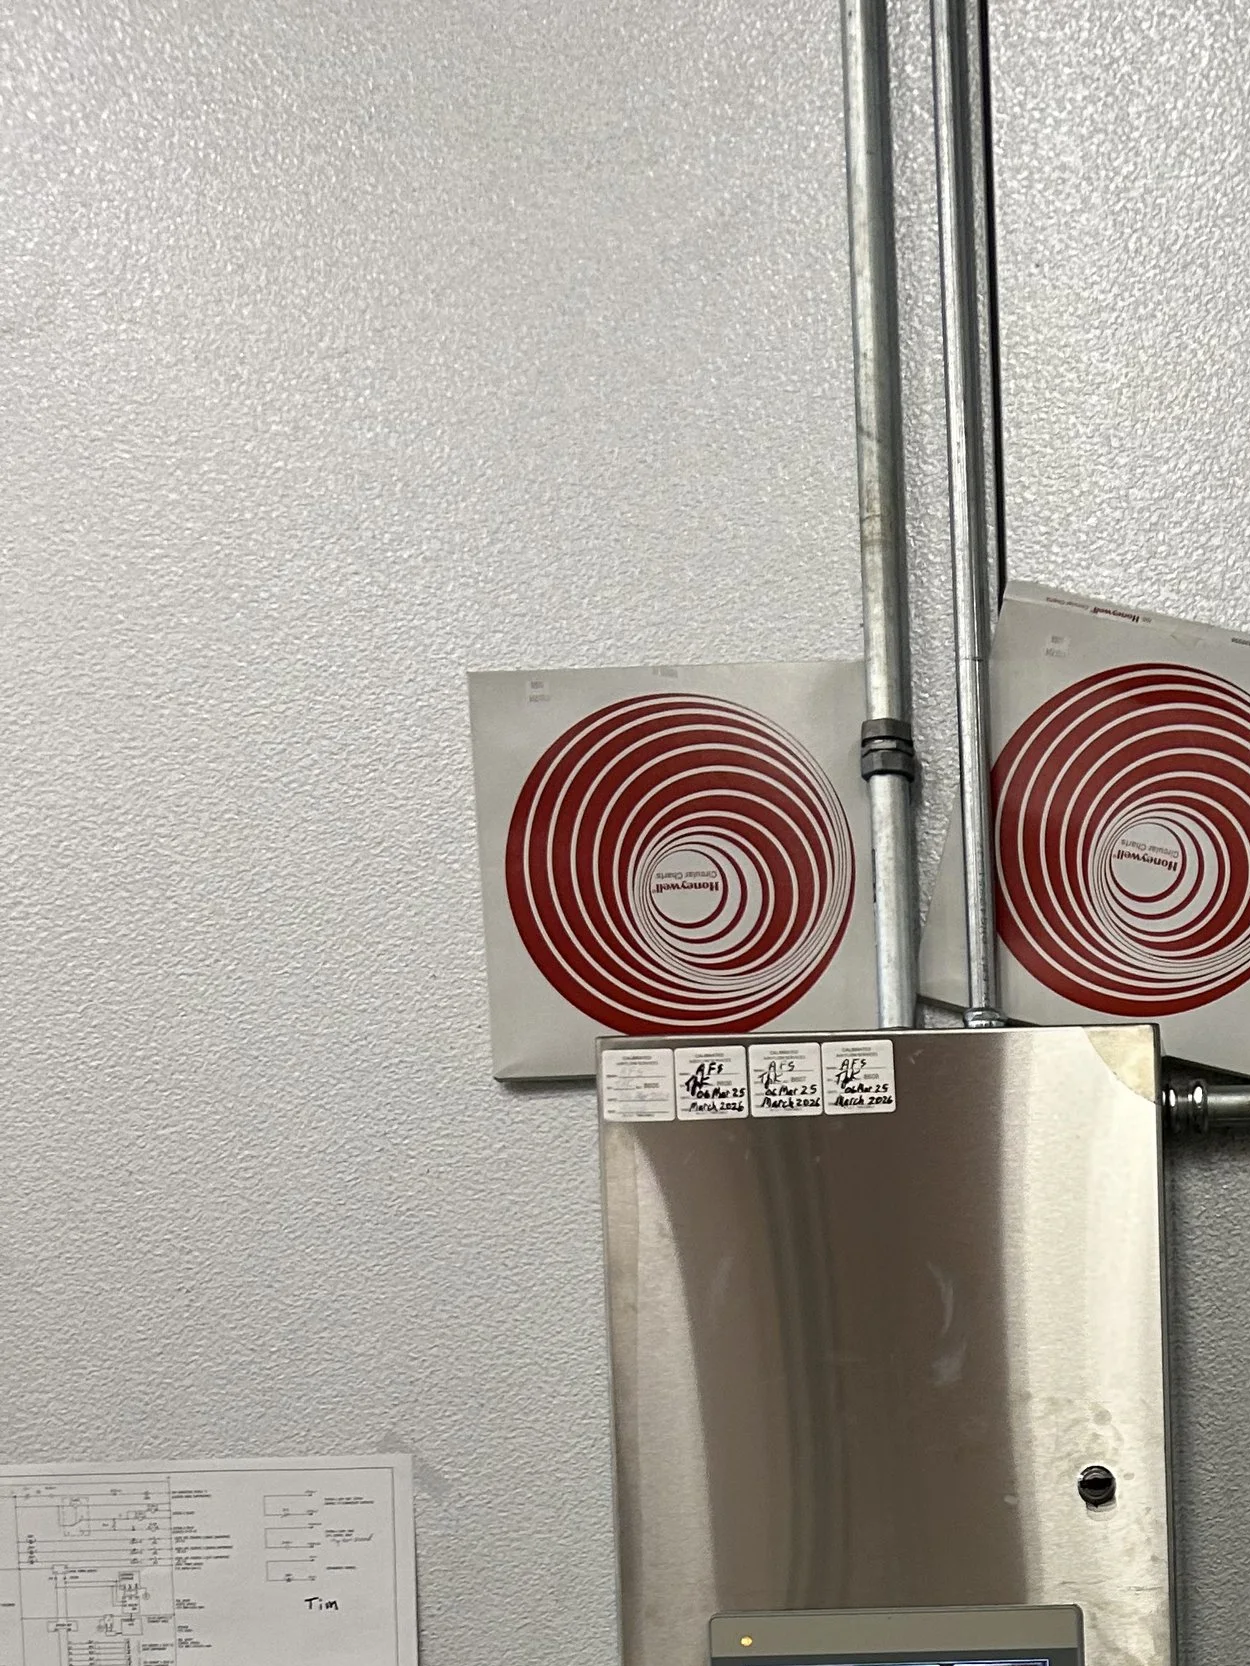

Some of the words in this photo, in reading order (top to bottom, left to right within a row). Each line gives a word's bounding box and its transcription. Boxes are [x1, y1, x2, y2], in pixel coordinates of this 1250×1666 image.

[732, 1087, 746, 1098] 25
[778, 1084, 798, 1096] Mar
[800, 1084, 817, 1095] 25
[874, 1083, 889, 1093] 25
[761, 1096, 794, 1109] March
[796, 1097, 821, 1107] 2026
[868, 1095, 893, 1105] 2026
[689, 1101, 718, 1113] March
[719, 1100, 744, 1112] 2026
[304, 1596, 339, 1611] Tim
